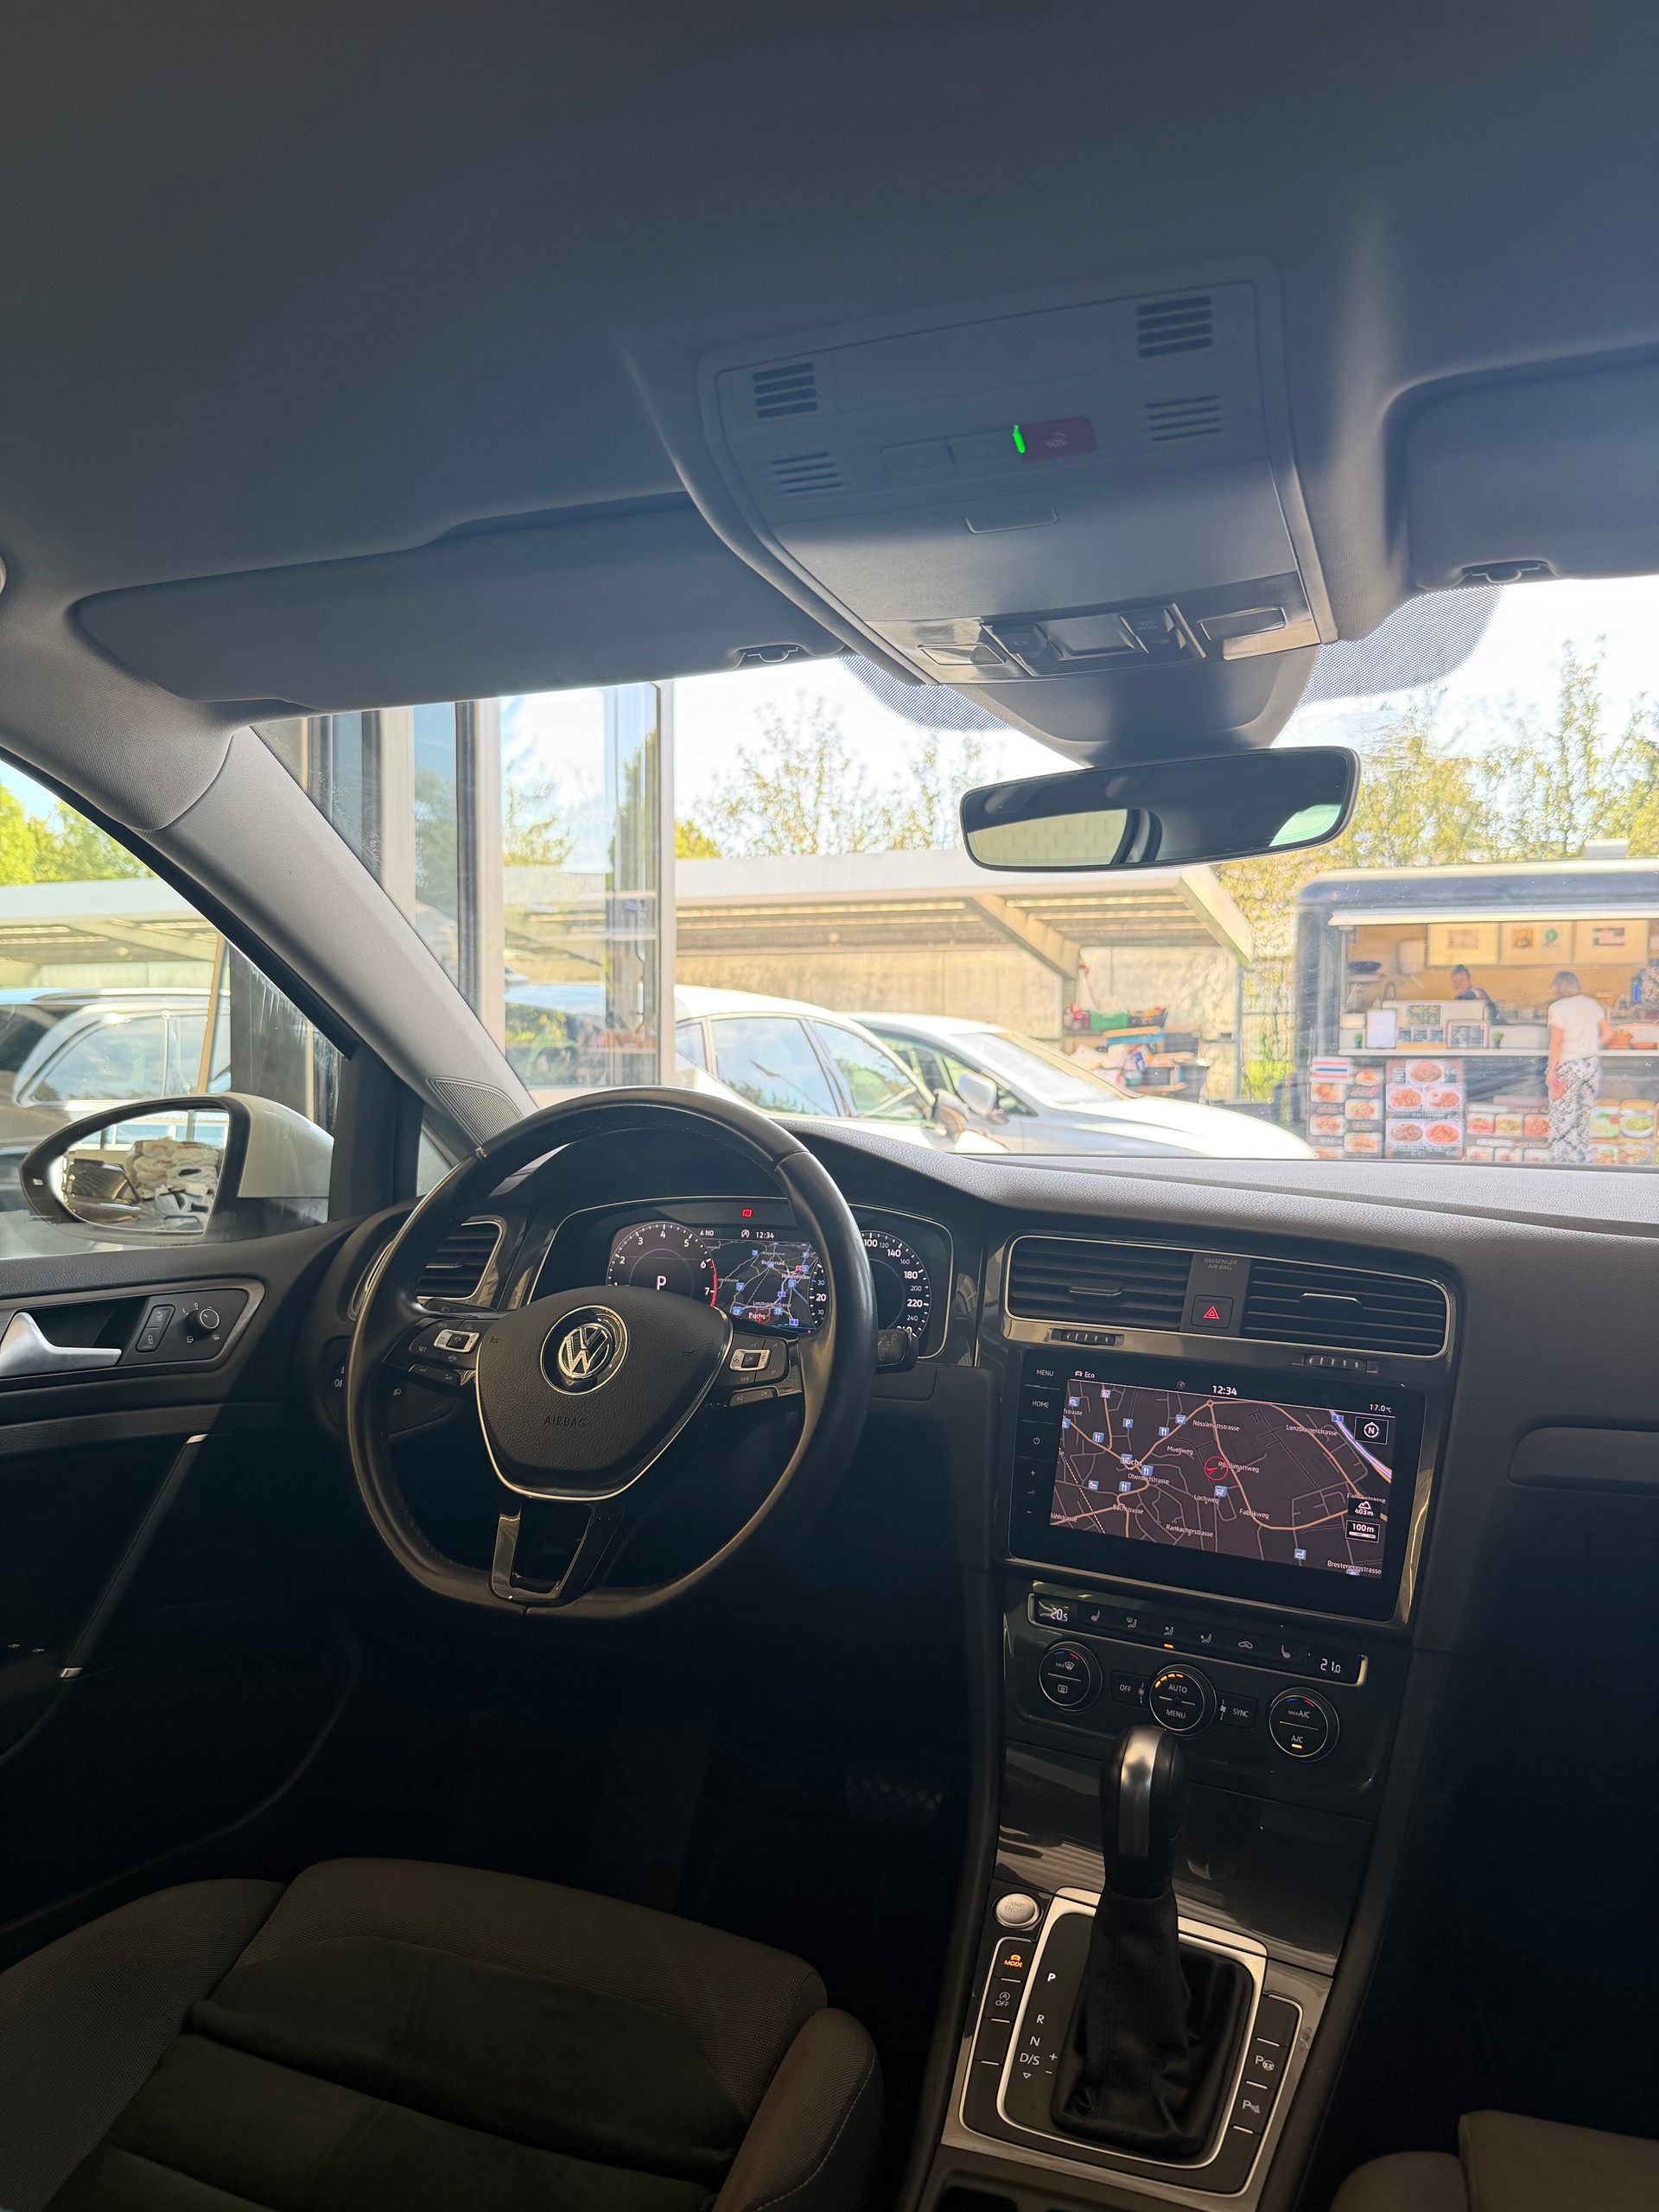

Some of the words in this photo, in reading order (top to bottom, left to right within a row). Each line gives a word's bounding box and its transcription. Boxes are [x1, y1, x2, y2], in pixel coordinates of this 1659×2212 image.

[659, 1230, 666, 1239] 4
[638, 1236, 644, 1245] 3
[864, 1238, 878, 1248] 100
[887, 1249, 901, 1257] 140
[620, 1255, 626, 1265] 2
[904, 1270, 918, 1280] 180
[657, 1275, 667, 1291] P
[704, 1287, 710, 1296] 7
[816, 1293, 827, 1302] 20
[907, 1299, 923, 1307] 220
[1212, 1385, 1237, 1396] 12:34
[1032, 1400, 1050, 1408] HOME
[543, 1416, 587, 1428] AIRBAG
[1192, 1420, 1240, 1432] Rösslimttstrasse
[1367, 1427, 1376, 1435] N
[1217, 1460, 1260, 1474] Rölimattweg
[1193, 1493, 1219, 1504] Lochweg
[1239, 1508, 1269, 1520] Fabikweg
[1166, 1523, 1214, 1537] Rankacherstrasse
[1050, 1607, 1068, 1622] 20.5
[1320, 1657, 1341, 1674] 21.0
[1119, 1684, 1132, 1693] OFF
[1168, 1683, 1188, 1694] AUTO
[1166, 1708, 1186, 1719] MENU
[1232, 1707, 1249, 1718] SYNC
[1003, 1959, 1024, 1968] MODE
[1046, 1972, 1057, 1982] P
[995, 1999, 1010, 2008] OFF
[1036, 2013, 1045, 2024] R
[1029, 2036, 1040, 2047] N
[1020, 2052, 1041, 2066] D/S
